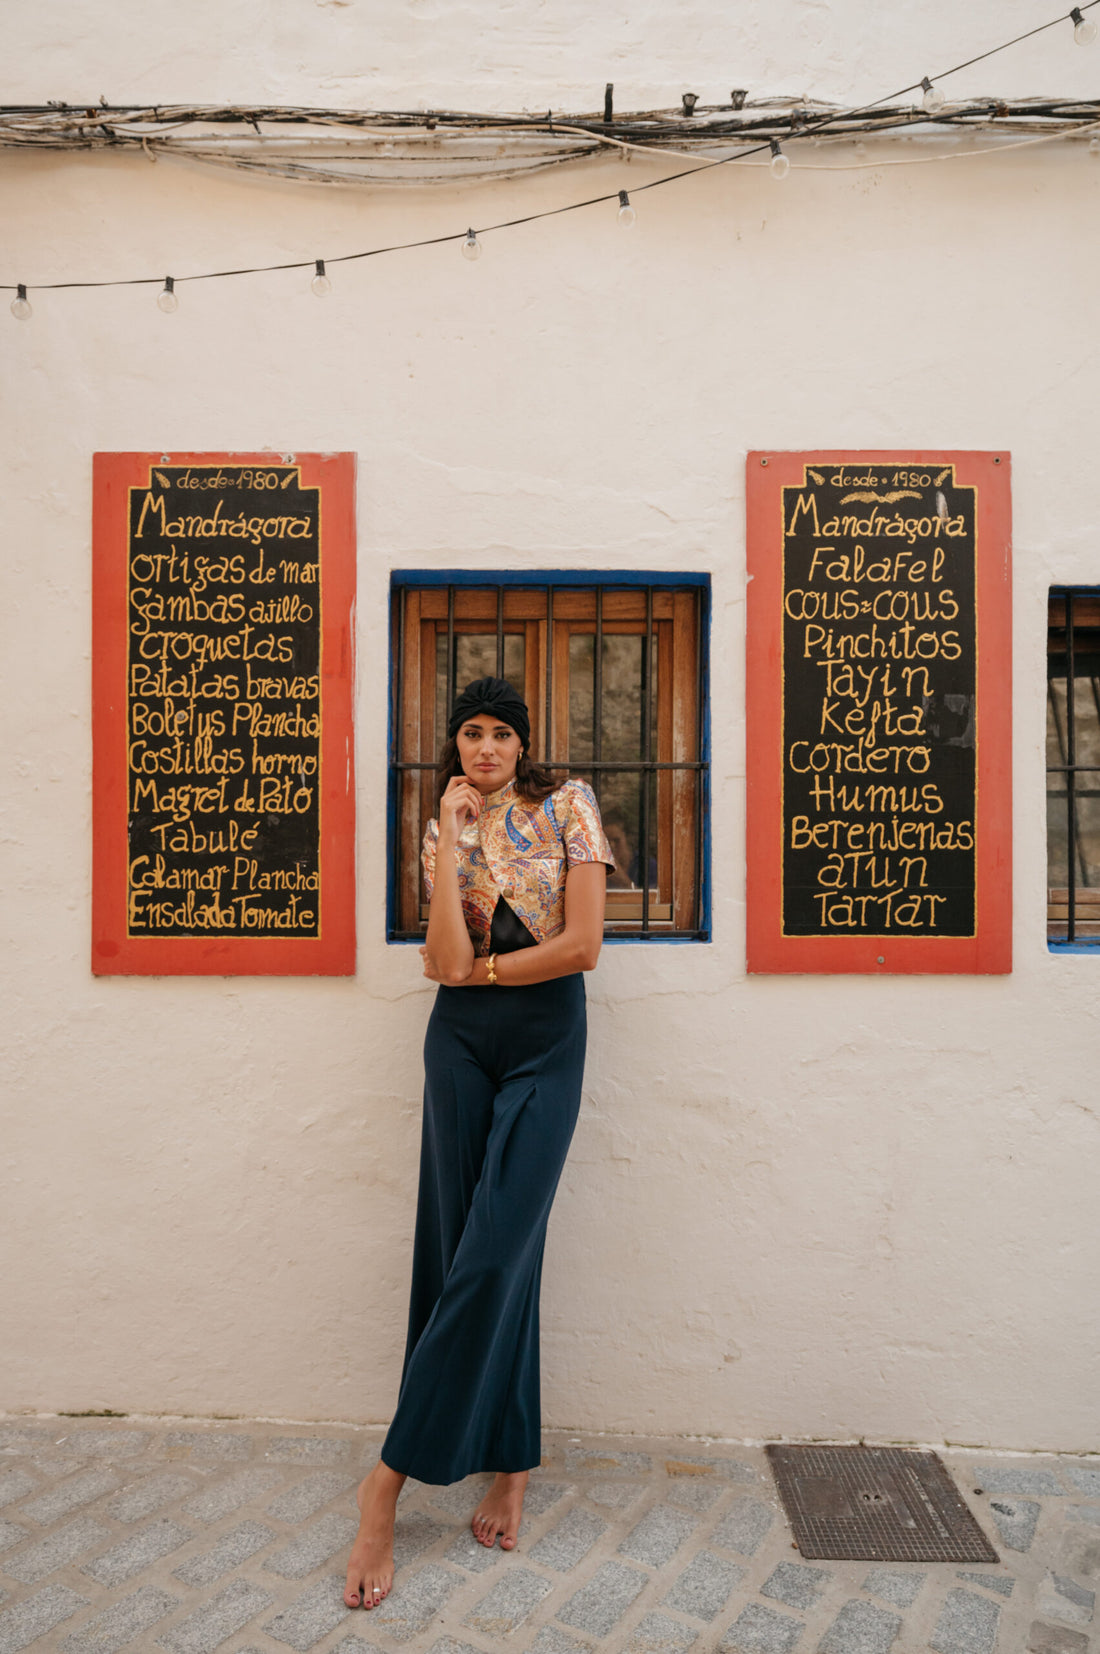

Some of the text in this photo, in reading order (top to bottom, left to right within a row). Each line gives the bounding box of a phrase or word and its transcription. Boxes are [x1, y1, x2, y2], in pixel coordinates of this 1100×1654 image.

[236, 470, 278, 490] 1980
[831, 467, 931, 487] desde 1980
[134, 491, 313, 544] Mandrágora
[785, 493, 967, 544] Mandrágora
[249, 549, 276, 584] de
[279, 560, 319, 583] mar
[249, 595, 313, 623] ajillo
[803, 621, 962, 660] Pinchitos
[130, 660, 319, 699] Patatas bravas
[817, 659, 934, 707] Tayin
[132, 698, 319, 737] Boletus Plancha
[821, 697, 926, 747] Kefta
[129, 736, 317, 775] Costillas horno
[790, 737, 931, 773] Cordero
[133, 776, 313, 821] Magret de Pato
[809, 774, 944, 813] Humus
[150, 820, 260, 853] Tabulé
[791, 815, 974, 851] Berenjenas
[130, 854, 319, 890] Calamar Plancha
[129, 890, 315, 928] Ensalada Tomate
